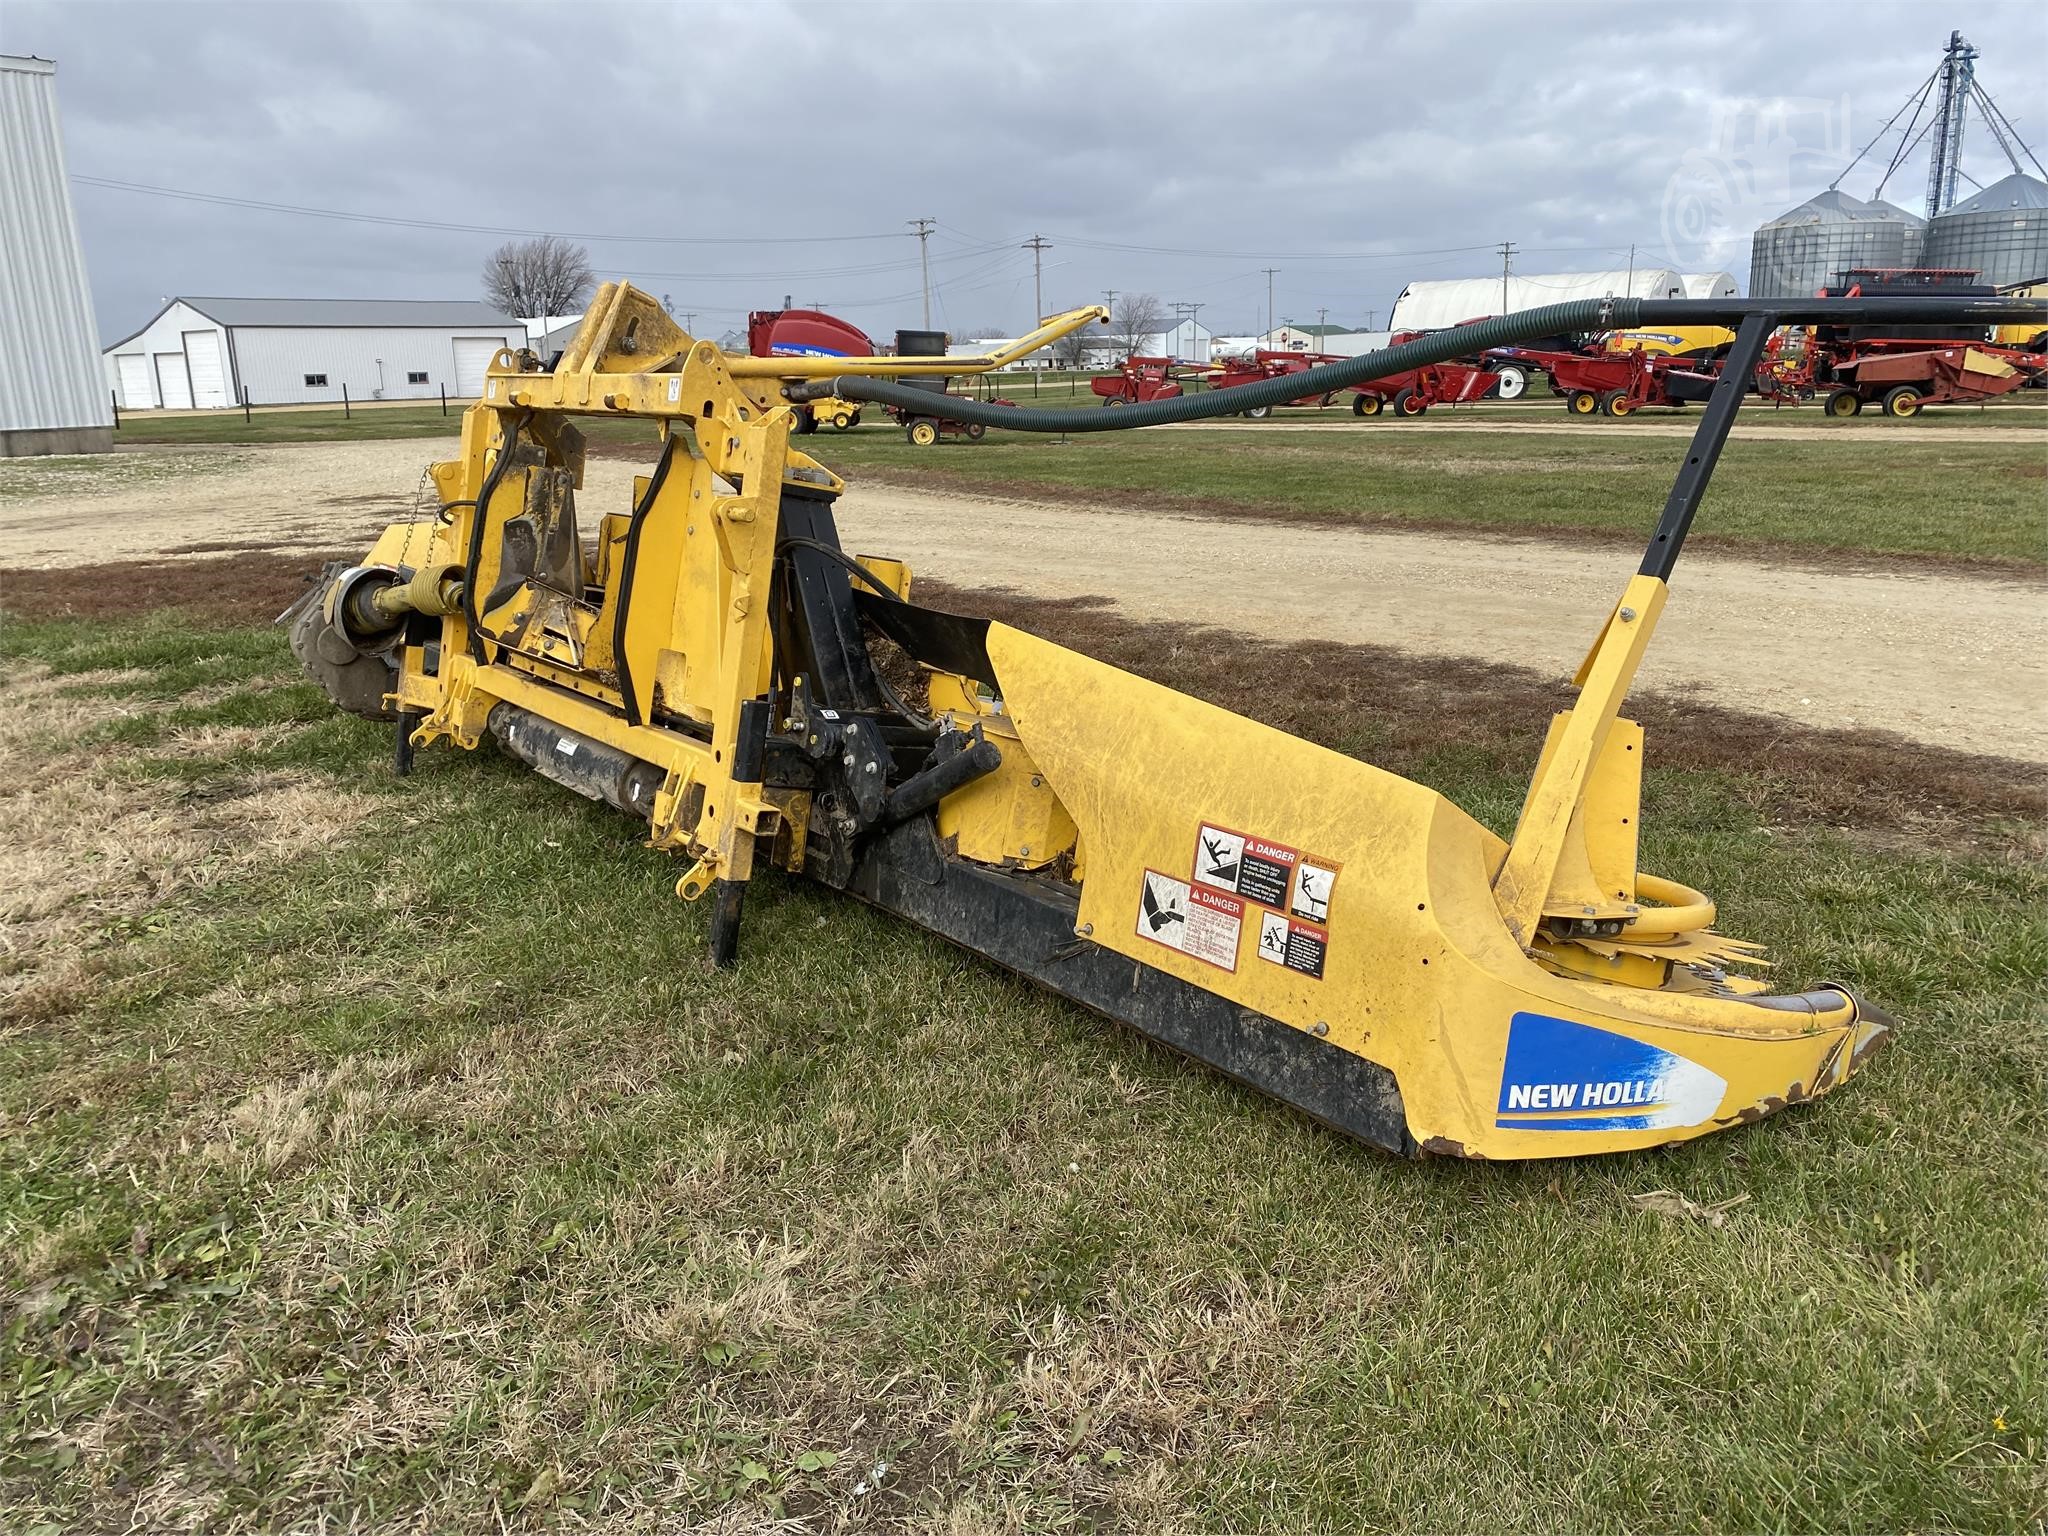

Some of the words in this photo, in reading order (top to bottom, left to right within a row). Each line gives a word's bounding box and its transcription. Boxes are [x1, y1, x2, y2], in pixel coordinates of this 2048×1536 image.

[1256, 844, 1295, 863] DANGER
[1311, 859, 1338, 871] WARNING
[1203, 893, 1240, 913] DANGER
[1301, 928, 1322, 939] DANGER
[1508, 1084, 1578, 1109] NEW
[1582, 1079, 1668, 1106] HOLLA
